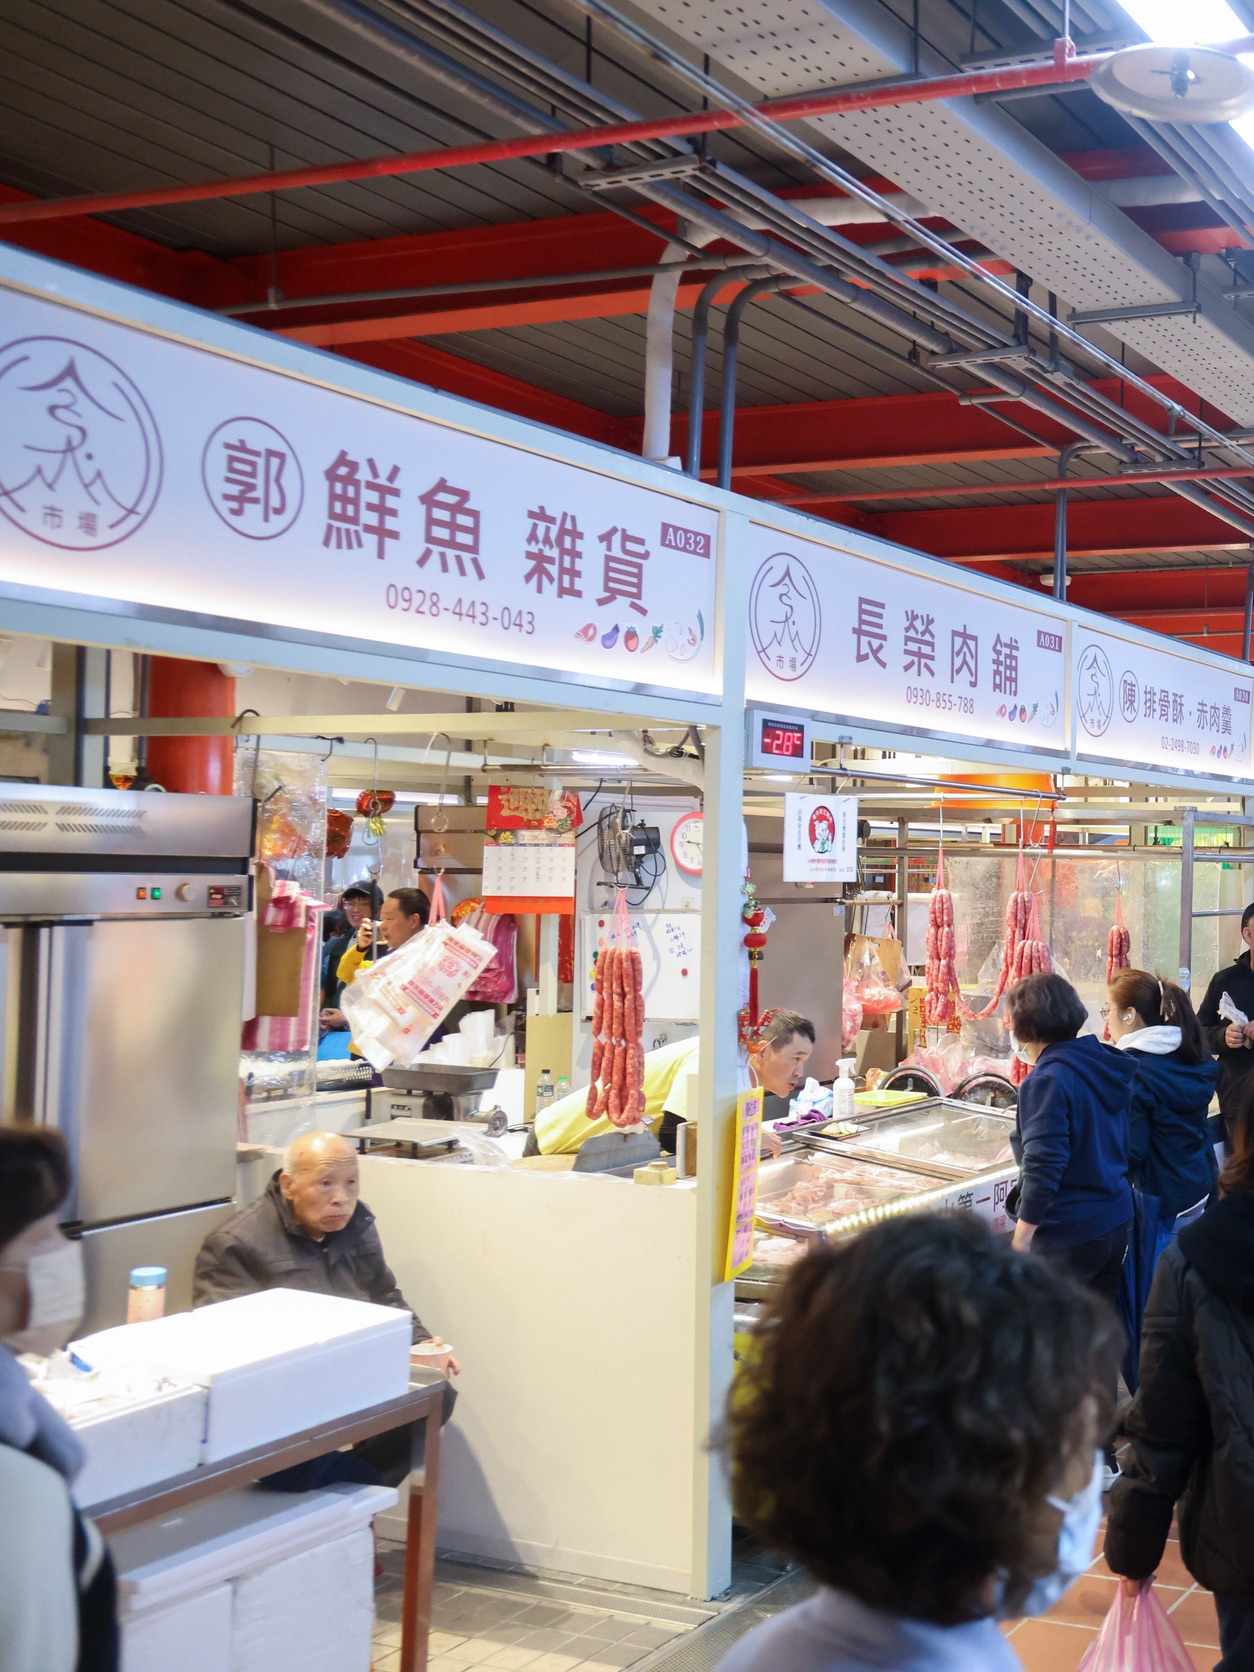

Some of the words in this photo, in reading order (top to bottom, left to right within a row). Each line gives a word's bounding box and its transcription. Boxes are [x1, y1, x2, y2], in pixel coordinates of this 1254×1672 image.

[221, 438, 288, 524] 郭
[321, 448, 487, 582] 鮮魚
[523, 504, 653, 618] 雜貨
[663, 526, 708, 556] A032
[384, 582, 537, 636] 0928-443-043
[851, 595, 1021, 698] 長榮肉舖
[1038, 632, 1061, 651] A031
[905, 684, 975, 716] 0930-855-788
[1122, 679, 1137, 715] 陳
